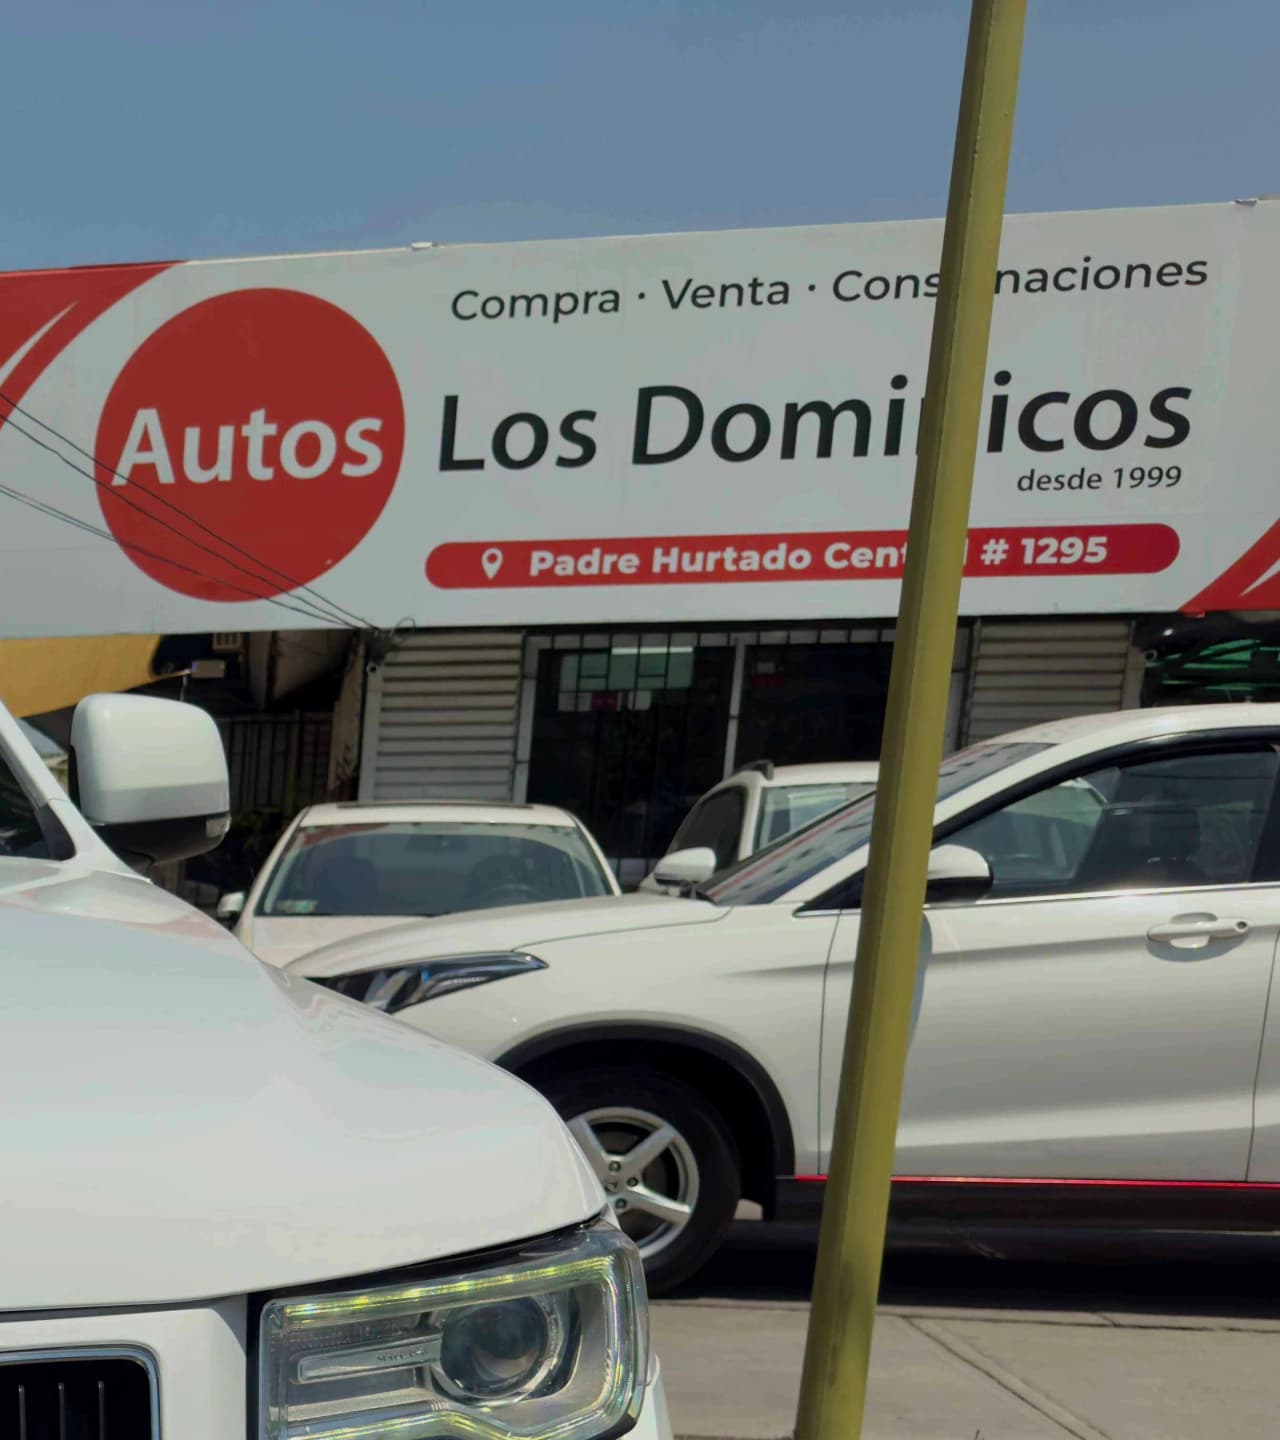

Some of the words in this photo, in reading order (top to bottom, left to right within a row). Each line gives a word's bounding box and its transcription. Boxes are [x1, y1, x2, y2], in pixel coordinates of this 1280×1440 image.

[451, 288, 621, 324] Compra
[661, 276, 790, 310] Venta
[832, 255, 1209, 302] Consnaciones
[111, 407, 383, 486] Autos
[439, 394, 597, 472] Los
[632, 369, 1193, 465] Domiicos
[1017, 466, 1103, 491] desde
[1114, 465, 1182, 489] 1999
[529, 546, 640, 577] Padre
[651, 544, 811, 574] Hurtado
[1020, 535, 1107, 565] 1295
